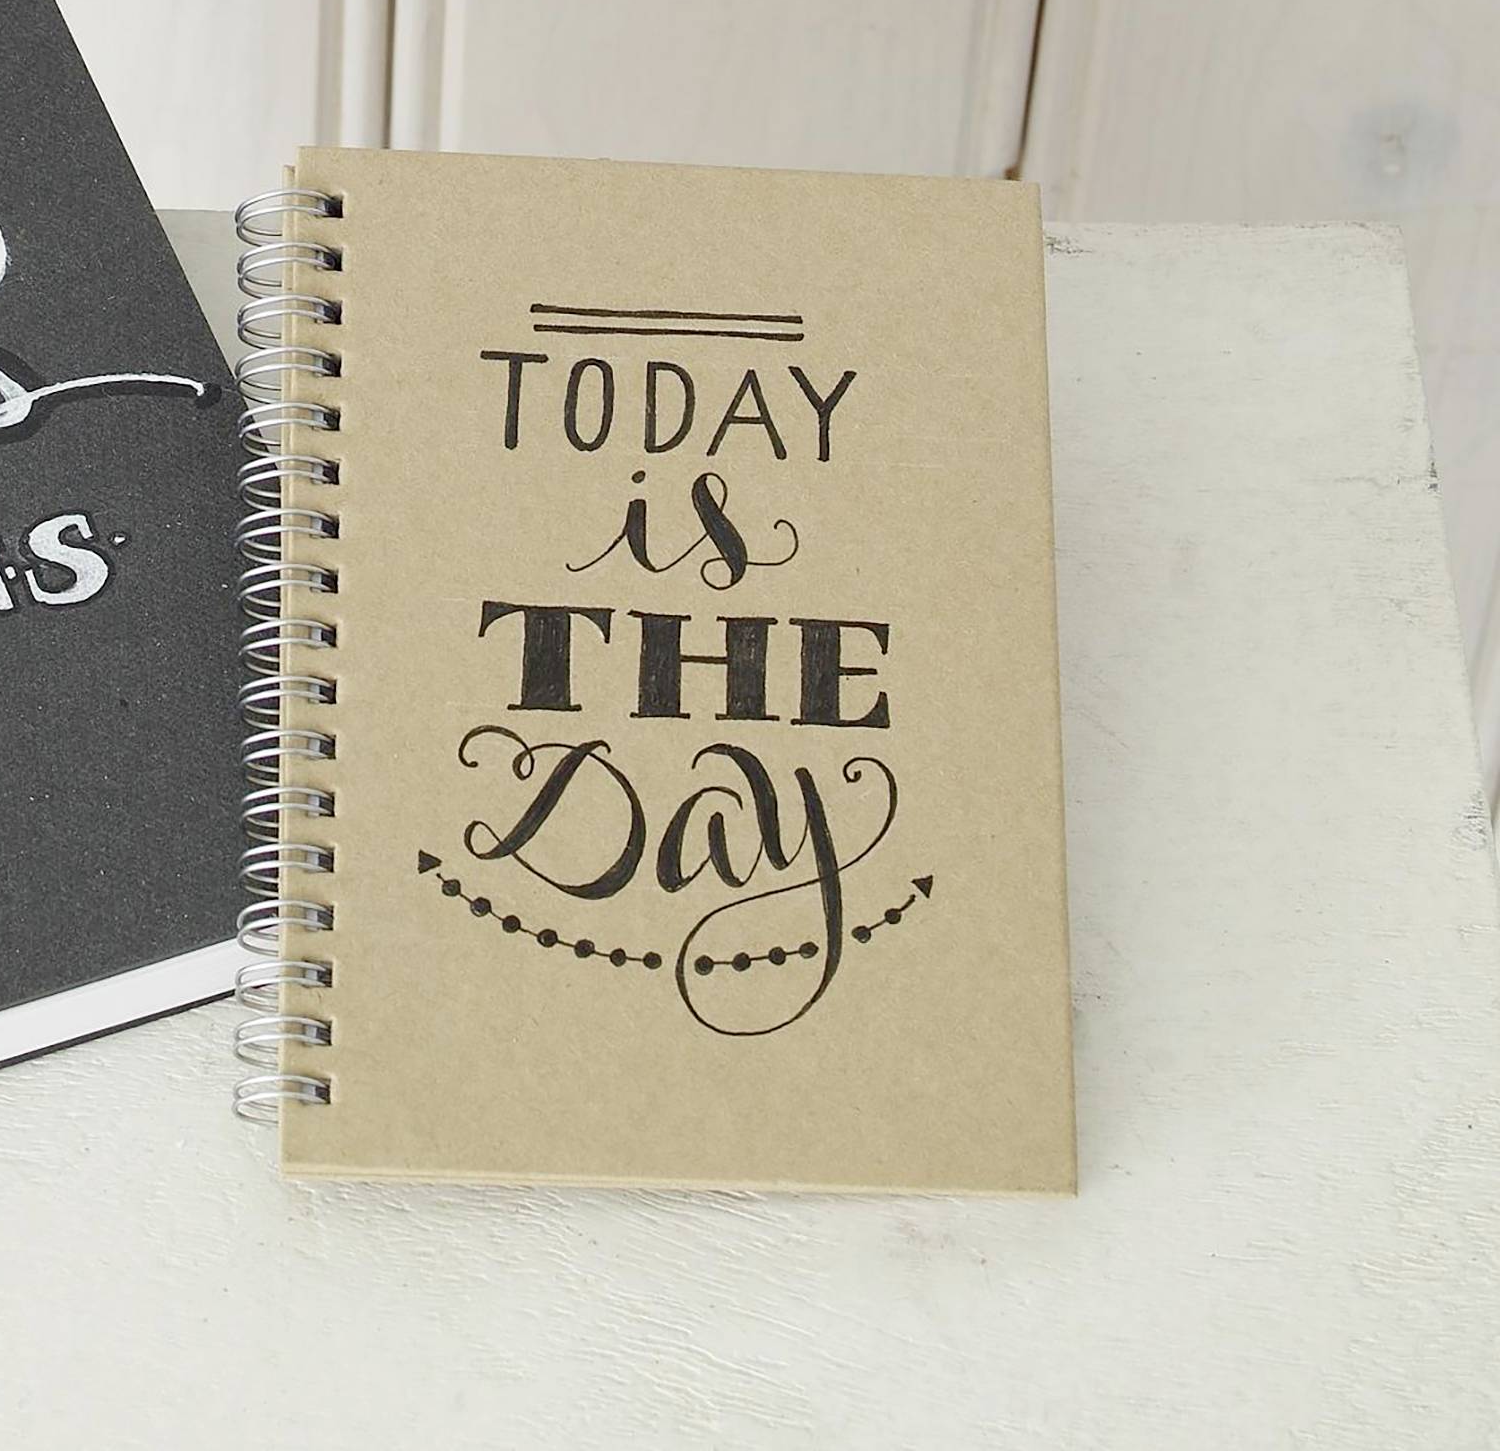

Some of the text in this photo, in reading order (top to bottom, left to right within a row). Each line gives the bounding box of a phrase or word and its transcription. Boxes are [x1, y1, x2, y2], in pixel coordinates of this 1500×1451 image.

[480, 349, 857, 463] TODAY
[566, 469, 799, 592] is
[478, 600, 891, 730] THE
[458, 723, 899, 1036] Day
